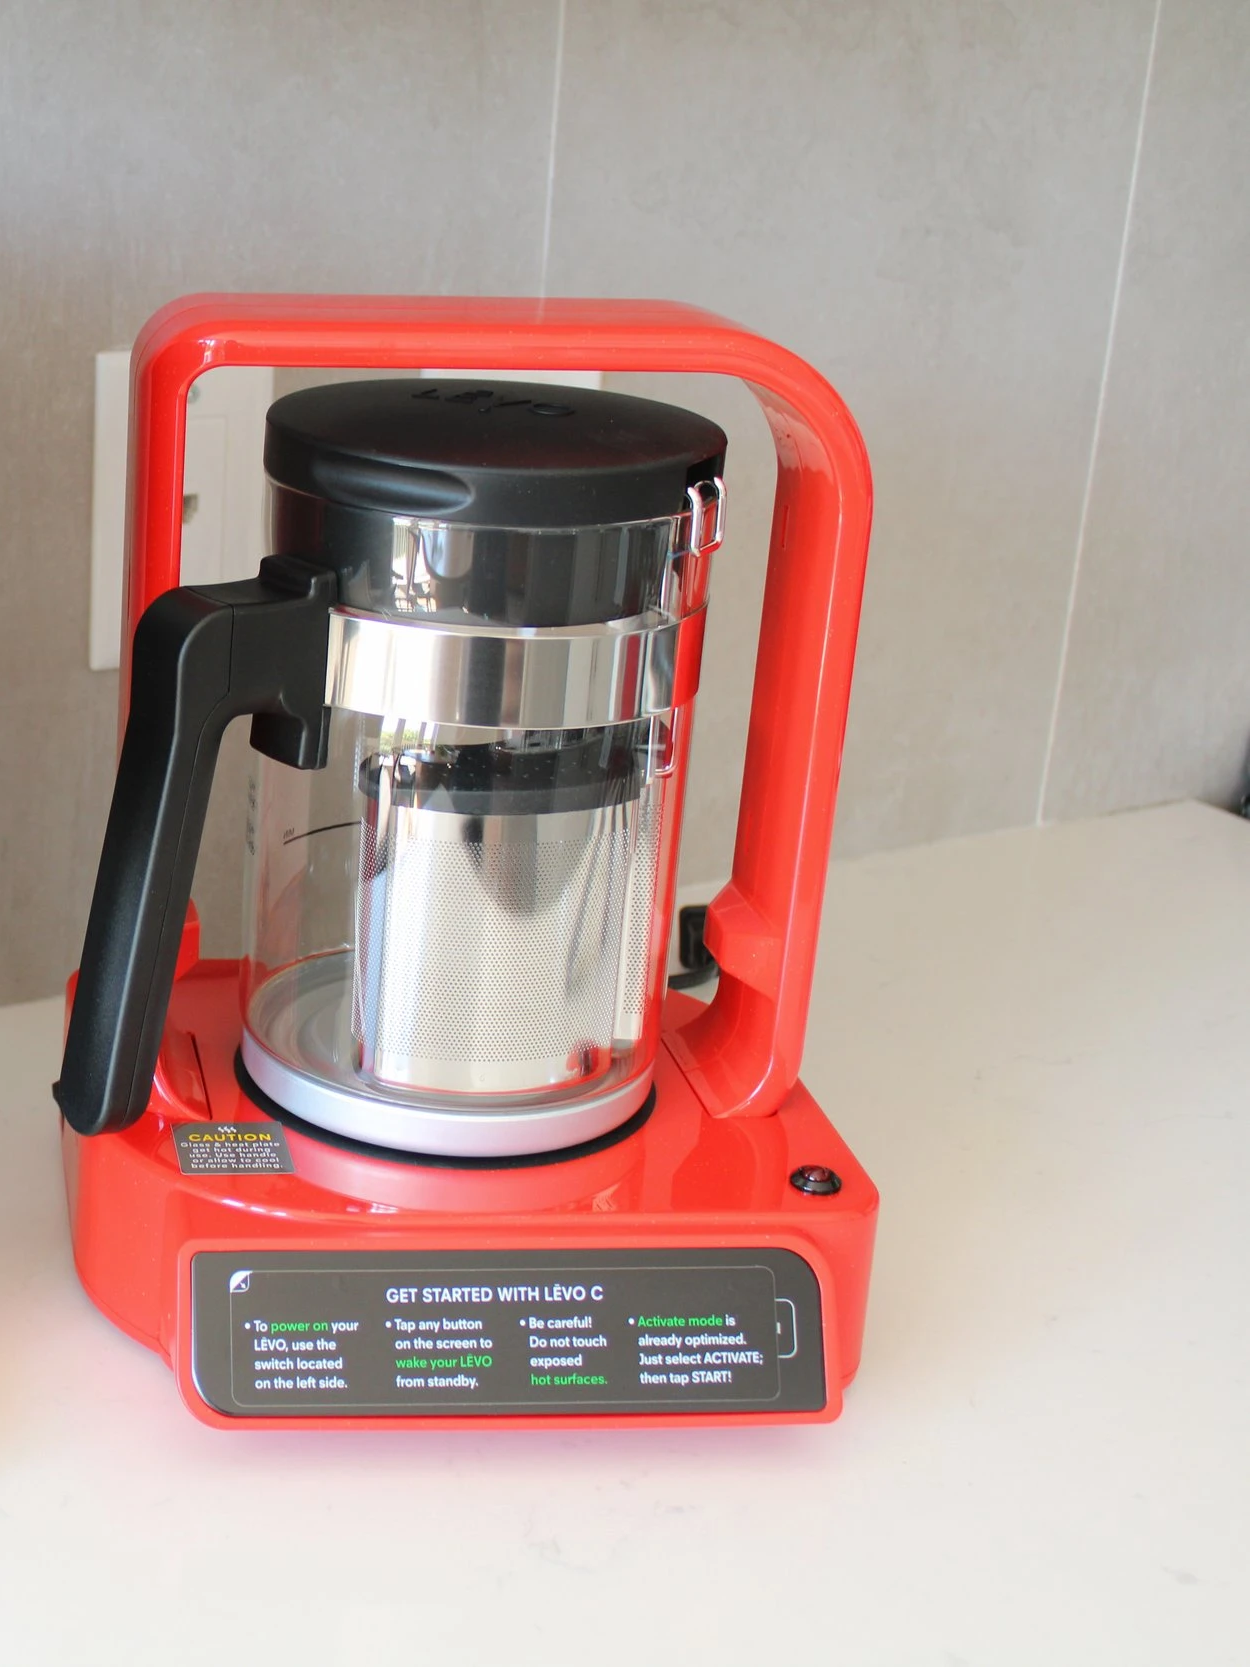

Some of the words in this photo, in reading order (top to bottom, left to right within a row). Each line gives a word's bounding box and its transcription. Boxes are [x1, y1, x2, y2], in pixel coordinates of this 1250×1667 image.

[189, 1133, 271, 1142] CAUTION
[386, 1288, 417, 1303] GET
[422, 1288, 493, 1302] STARTED
[497, 1286, 539, 1301] WITH
[545, 1284, 586, 1301] LĒVO
[591, 1286, 603, 1300] C
[254, 1320, 268, 1332] To
[271, 1321, 310, 1334] power
[313, 1321, 328, 1331] on
[331, 1321, 359, 1334] your
[394, 1319, 416, 1333] Tap
[419, 1321, 440, 1332] any
[443, 1318, 483, 1330] button
[529, 1318, 544, 1329] Be
[547, 1316, 592, 1329] careful!
[638, 1316, 685, 1327] Activate
[689, 1315, 723, 1326] mode
[726, 1314, 735, 1326] is
[292, 1341, 313, 1351] use
[316, 1339, 336, 1350] the
[395, 1339, 410, 1349] on
[413, 1338, 433, 1349] the
[436, 1338, 477, 1348] screen
[480, 1338, 493, 1348] to
[529, 1336, 547, 1348] Do
[550, 1336, 570, 1347] not
[573, 1335, 607, 1347] touch
[638, 1334, 682, 1348] already
[685, 1333, 747, 1347] optimized.
[254, 1357, 293, 1370] switch
[297, 1357, 343, 1369] located
[396, 1357, 427, 1368] wake
[430, 1357, 457, 1370] your
[530, 1354, 582, 1369] exposed
[639, 1354, 666, 1365] Just
[665, 1352, 702, 1364] select
[704, 1352, 763, 1364] ACTIVATE;
[255, 1379, 270, 1389] on
[273, 1377, 293, 1389] the
[297, 1377, 316, 1388] left
[319, 1376, 348, 1388] side.
[396, 1376, 425, 1387] from
[428, 1375, 478, 1389] standby.
[531, 1374, 551, 1385] hot
[554, 1373, 607, 1385] surfaces.
[640, 1372, 667, 1384] then
[669, 1373, 689, 1385] tap
[691, 1371, 732, 1383] START!
